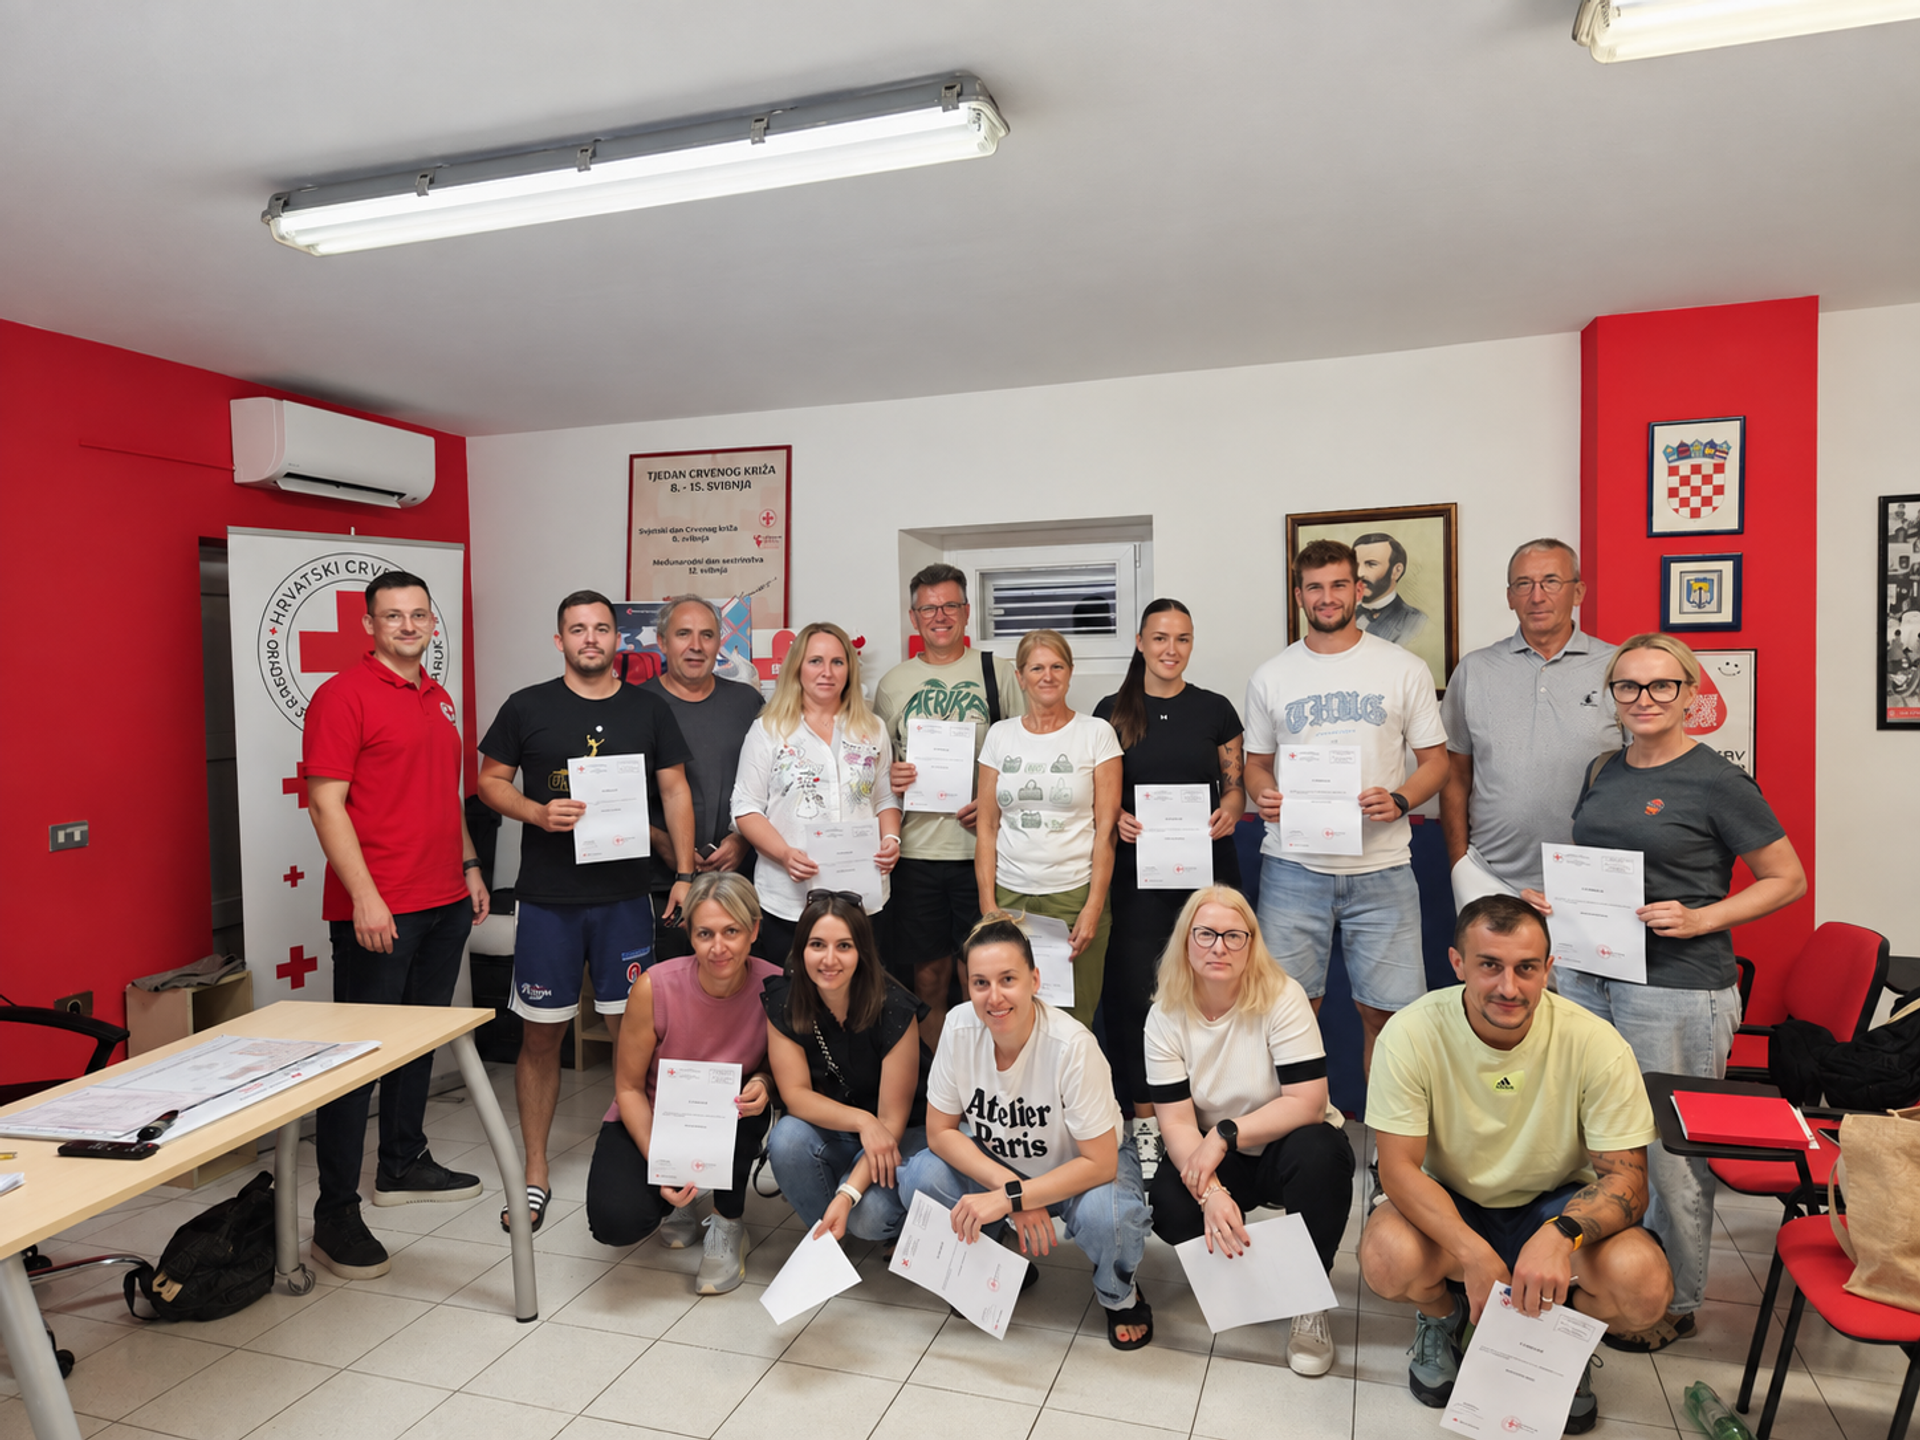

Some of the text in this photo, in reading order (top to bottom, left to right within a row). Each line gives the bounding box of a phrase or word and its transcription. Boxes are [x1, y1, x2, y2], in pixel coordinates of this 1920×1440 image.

[647, 463, 776, 482] TJEDAN CRVENOG KRIŽA
[707, 480, 751, 491] SVIBNJA
[669, 526, 684, 534] dan
[269, 561, 340, 626] HRVATSKI
[904, 689, 989, 727] AFRIKA
[966, 1087, 1051, 1129] Atelier
[975, 1121, 1048, 1158] Paris
